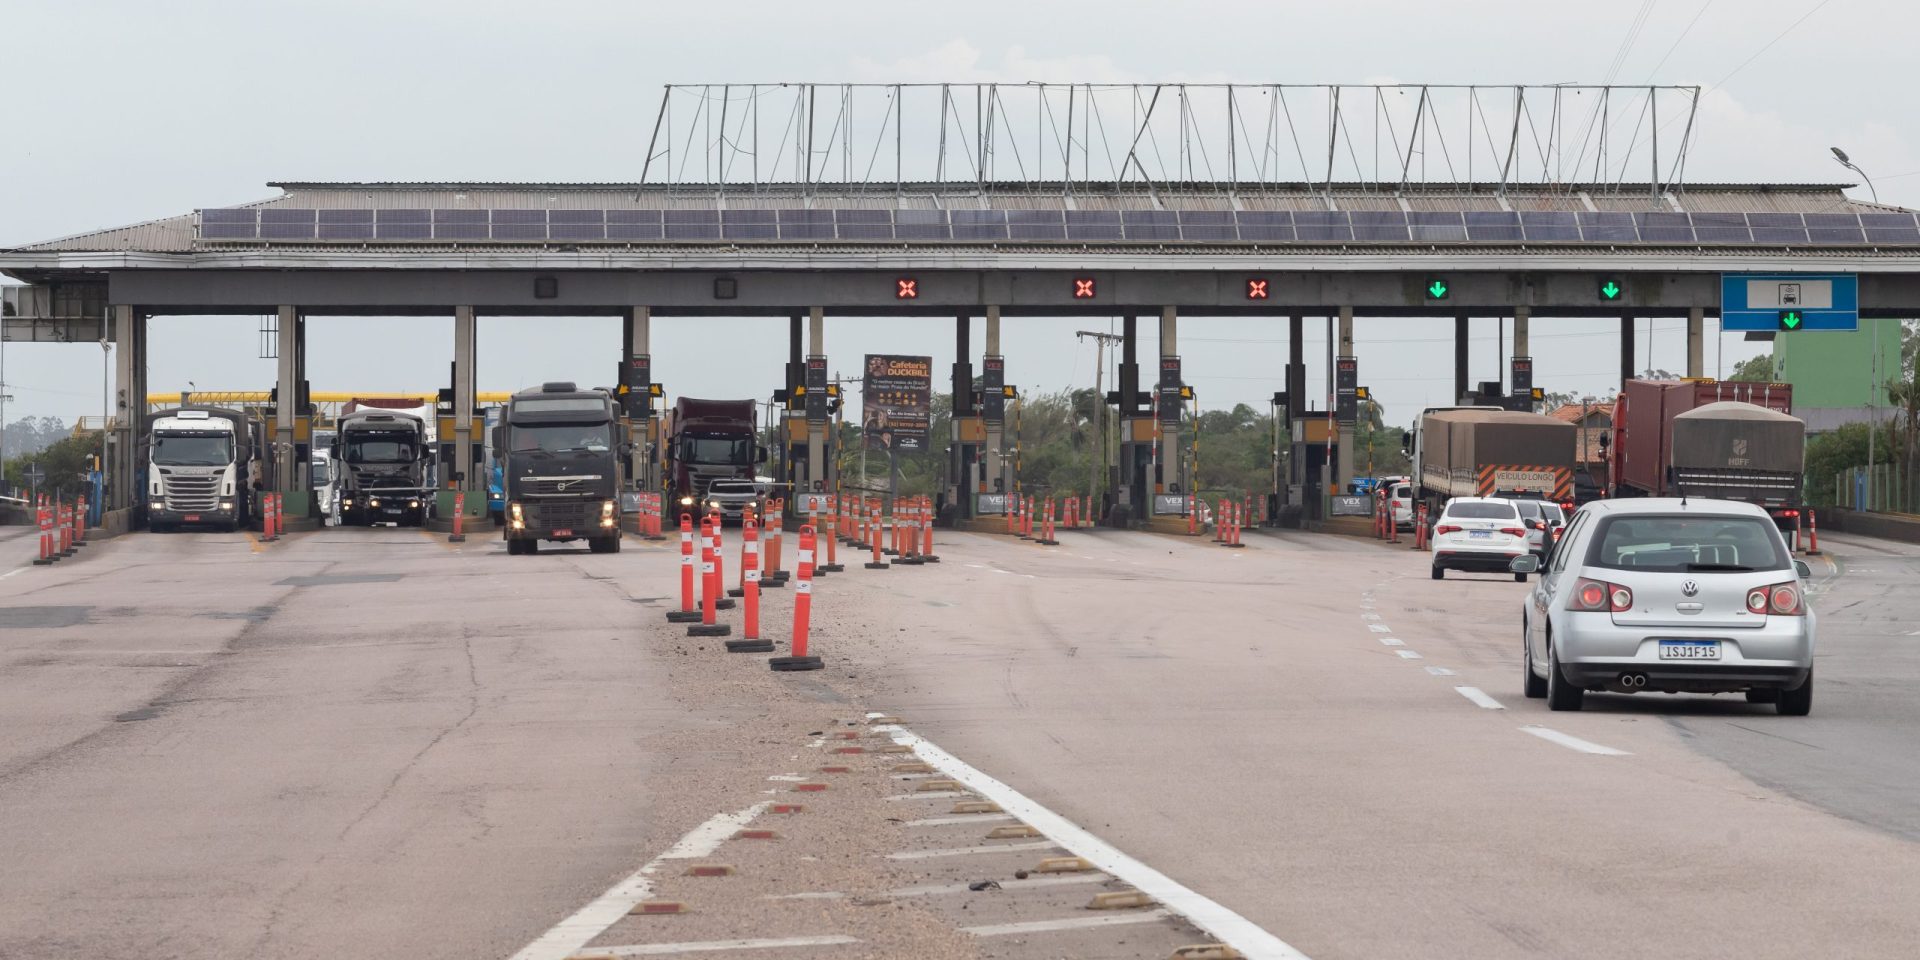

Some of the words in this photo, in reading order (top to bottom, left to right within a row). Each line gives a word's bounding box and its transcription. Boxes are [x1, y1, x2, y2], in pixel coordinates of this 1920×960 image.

[890, 361, 926, 369] Cafeteria
[888, 369, 929, 377] DUCKBILL
[1497, 471, 1527, 480] VEÍCULO
[1528, 472, 1554, 481] LONGO
[1666, 646, 1716, 657] ISJ1F15
